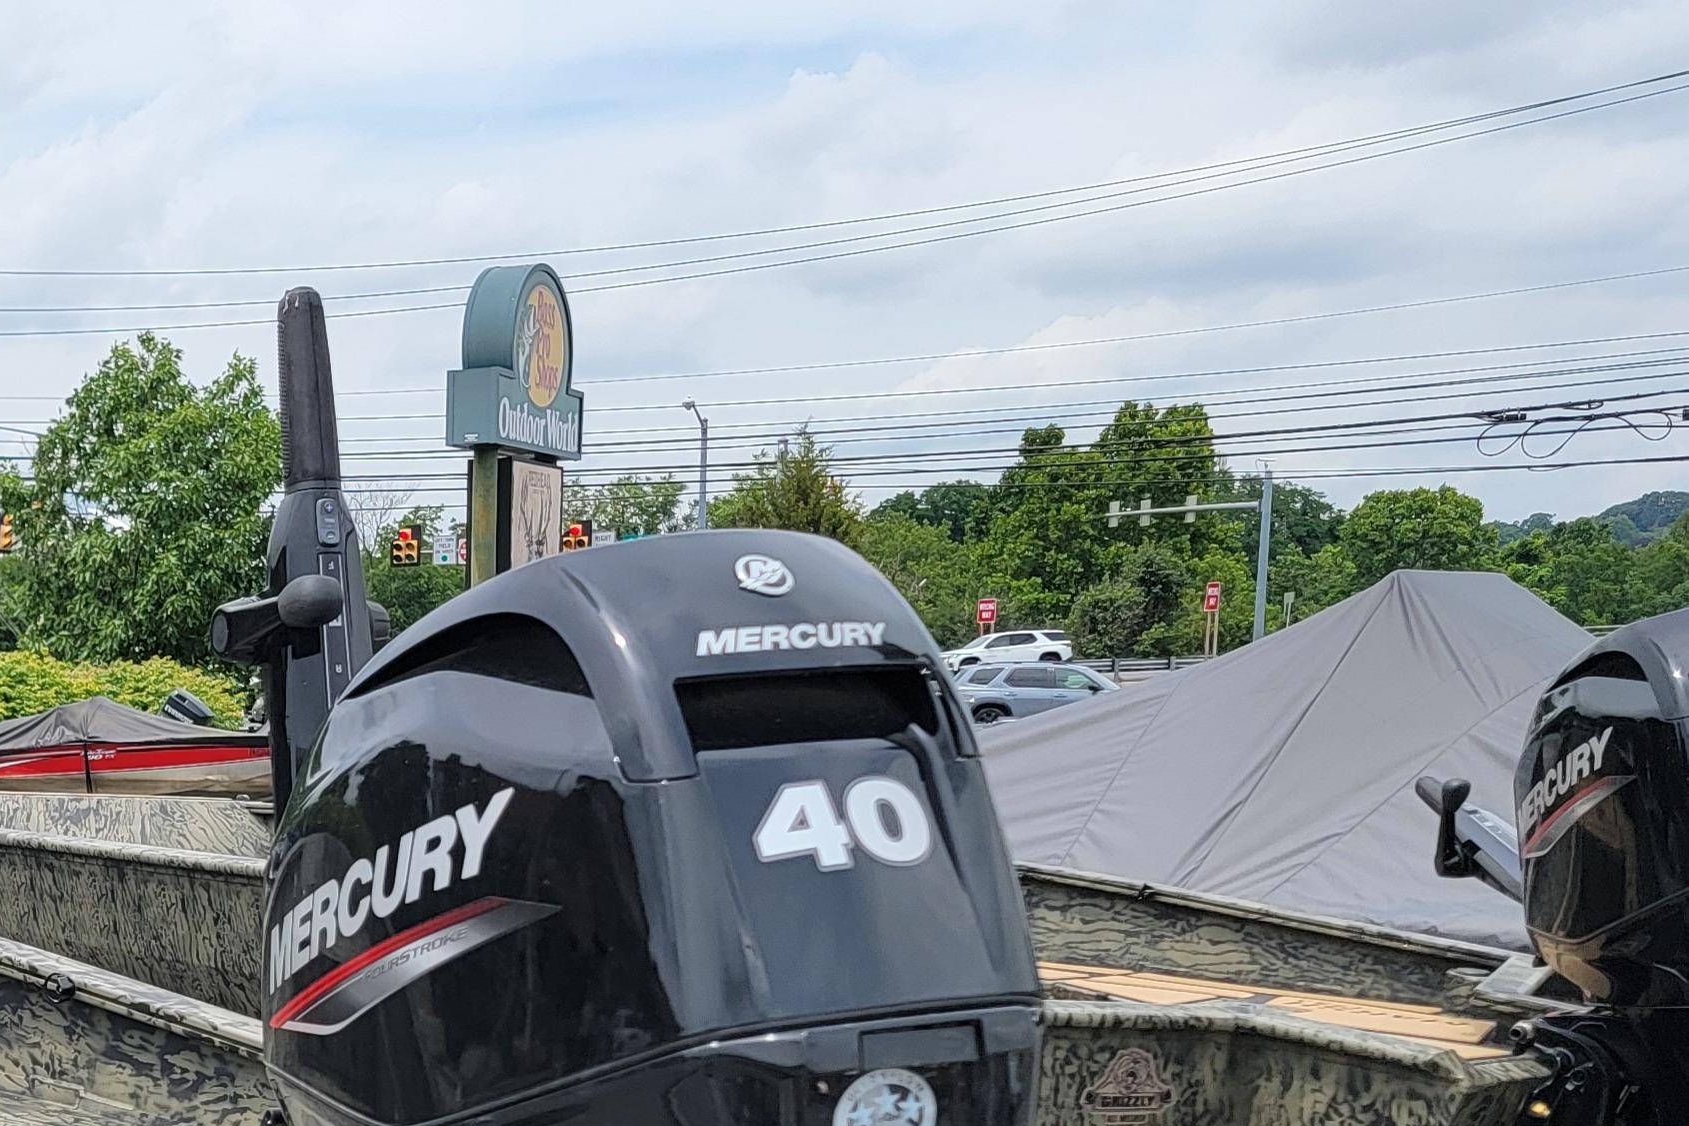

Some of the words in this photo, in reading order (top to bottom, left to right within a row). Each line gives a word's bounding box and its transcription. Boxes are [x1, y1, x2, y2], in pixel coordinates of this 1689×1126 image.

[535, 290, 556, 328] Bass
[535, 325, 551, 359] Pro
[535, 352, 559, 399] Shops
[498, 396, 546, 449] Outdoor
[546, 408, 579, 453] World
[696, 621, 886, 657] MERCURY
[754, 776, 932, 870] 40
[270, 787, 515, 995] MERCURY
[364, 925, 469, 980] FOURSTROKE
[1101, 1095, 1155, 1108] GRIZZLY
